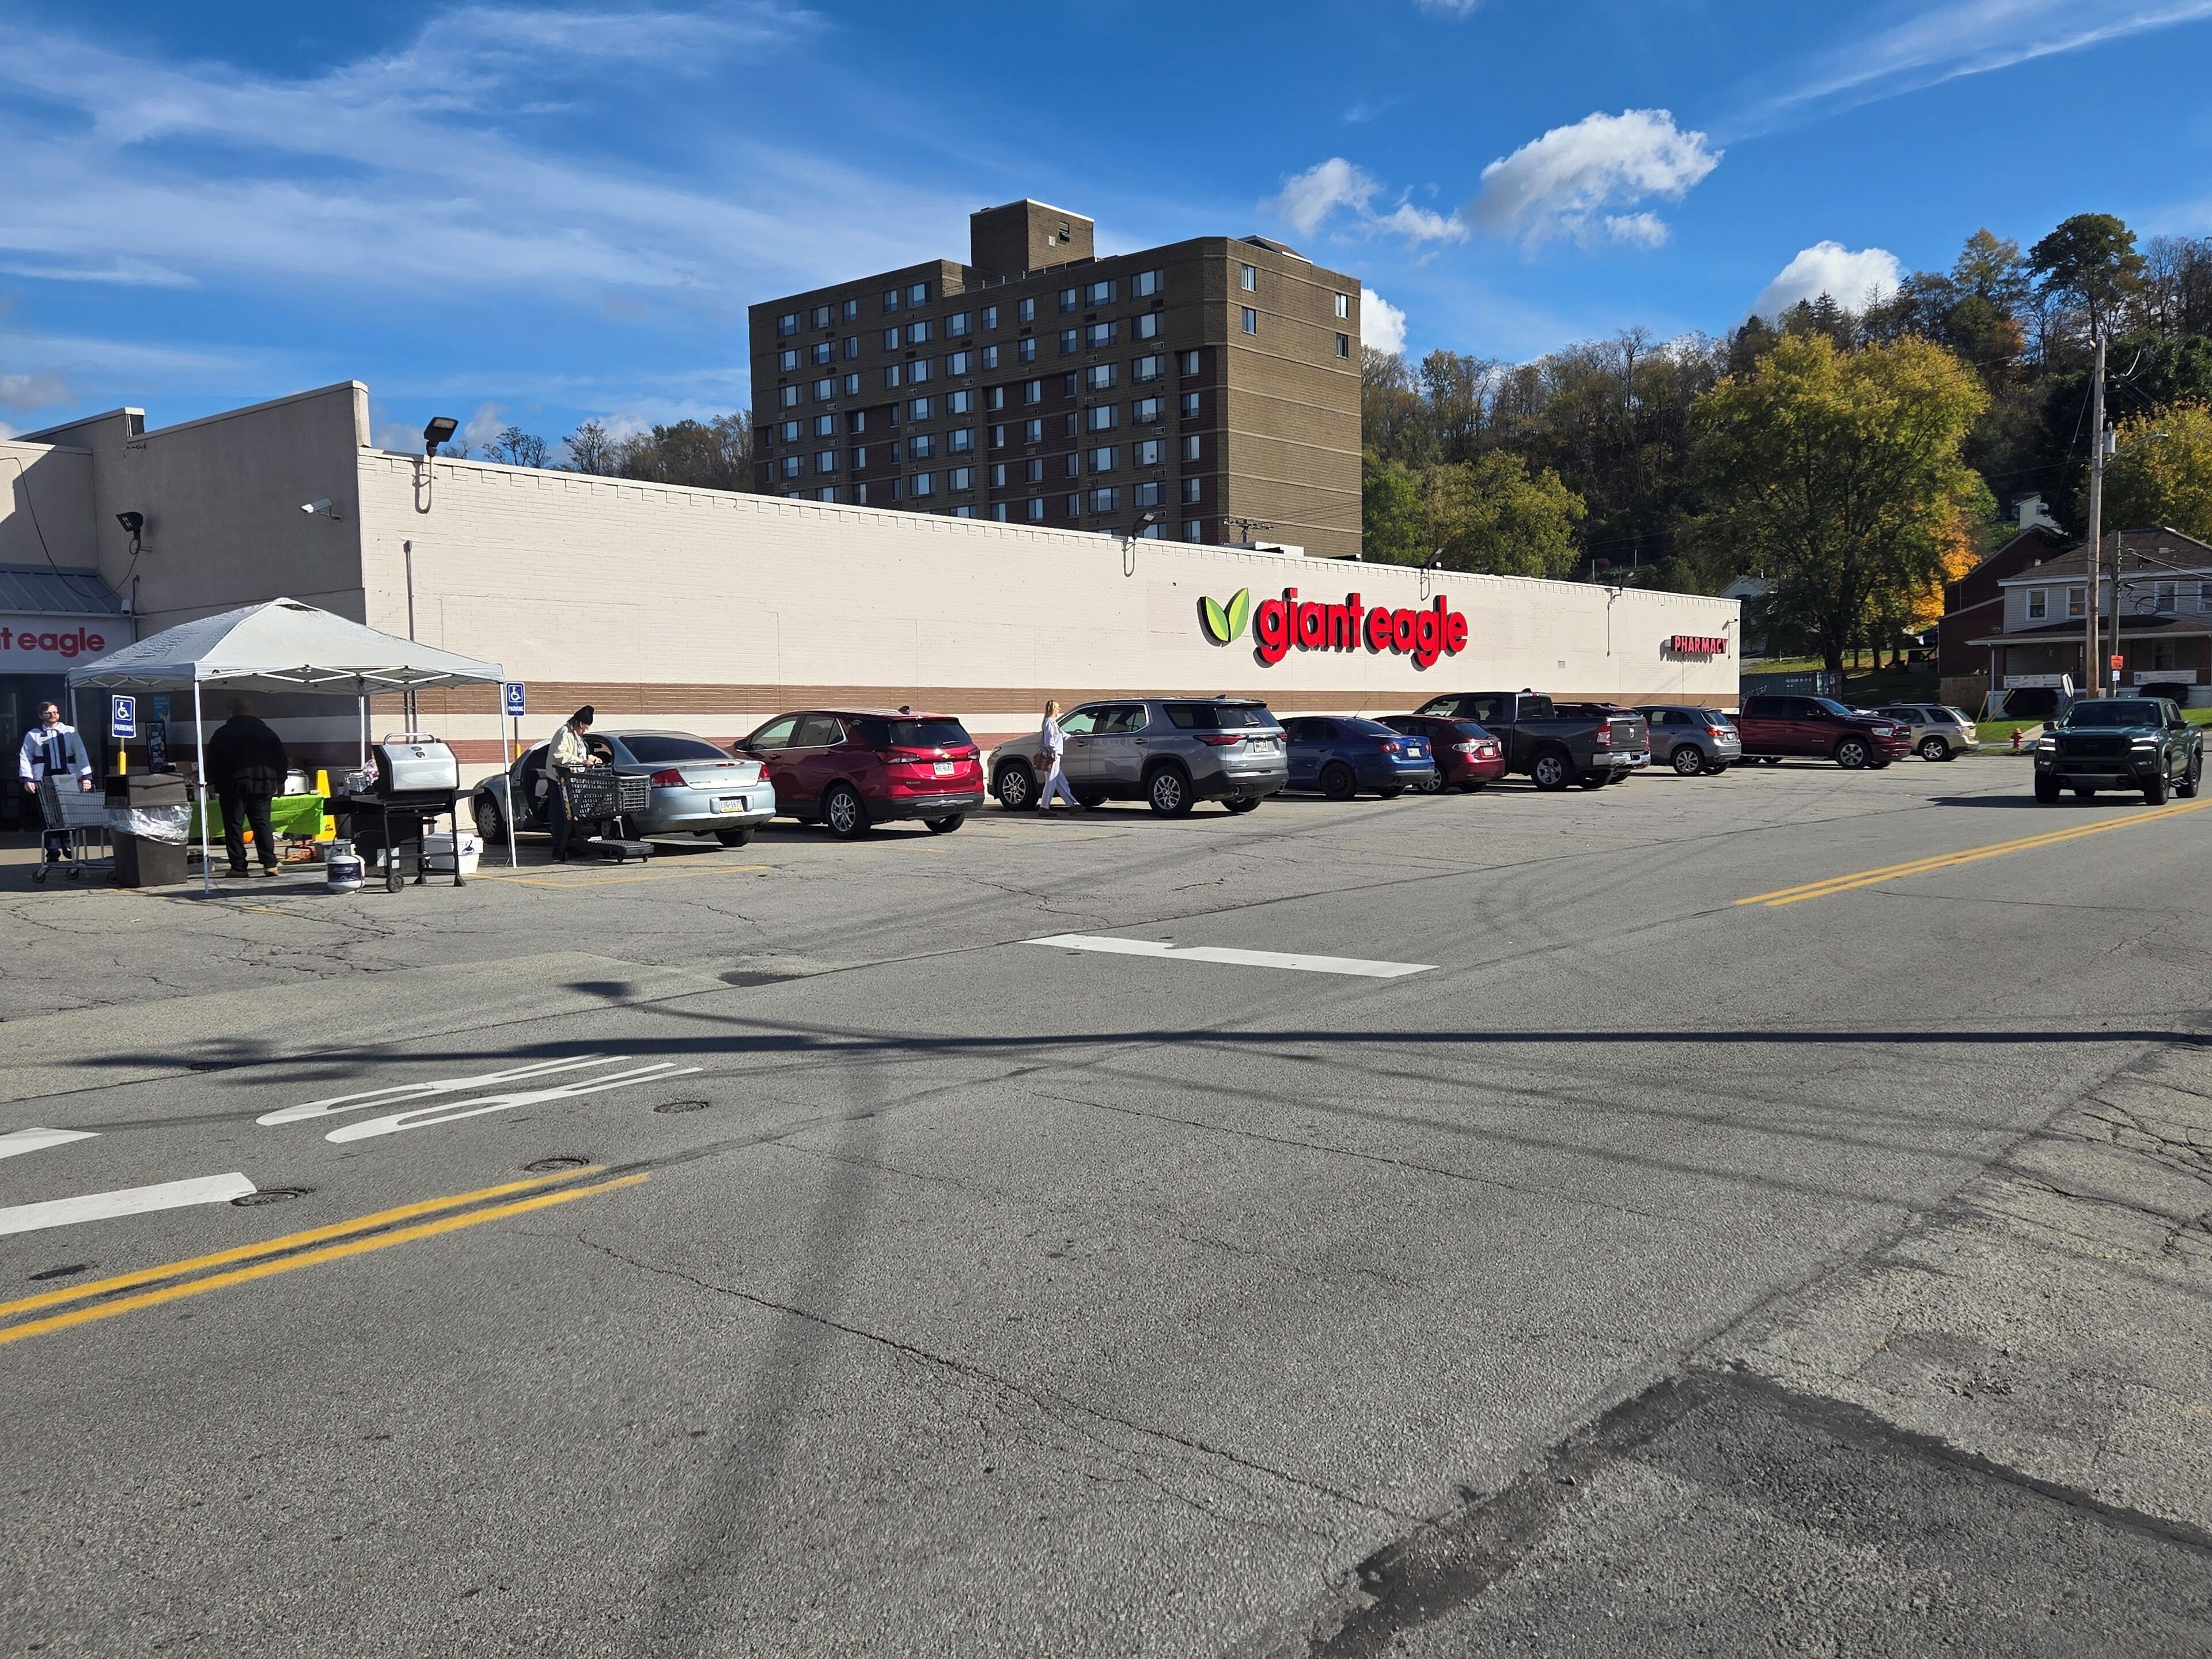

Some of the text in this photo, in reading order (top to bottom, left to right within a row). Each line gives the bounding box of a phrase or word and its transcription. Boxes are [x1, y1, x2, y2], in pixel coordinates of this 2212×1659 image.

[1260, 587, 1468, 667] giant eagle
[17, 627, 106, 658] eagle
[1675, 635, 1728, 654] PHARMACY
[113, 723, 134, 732] PARKING
